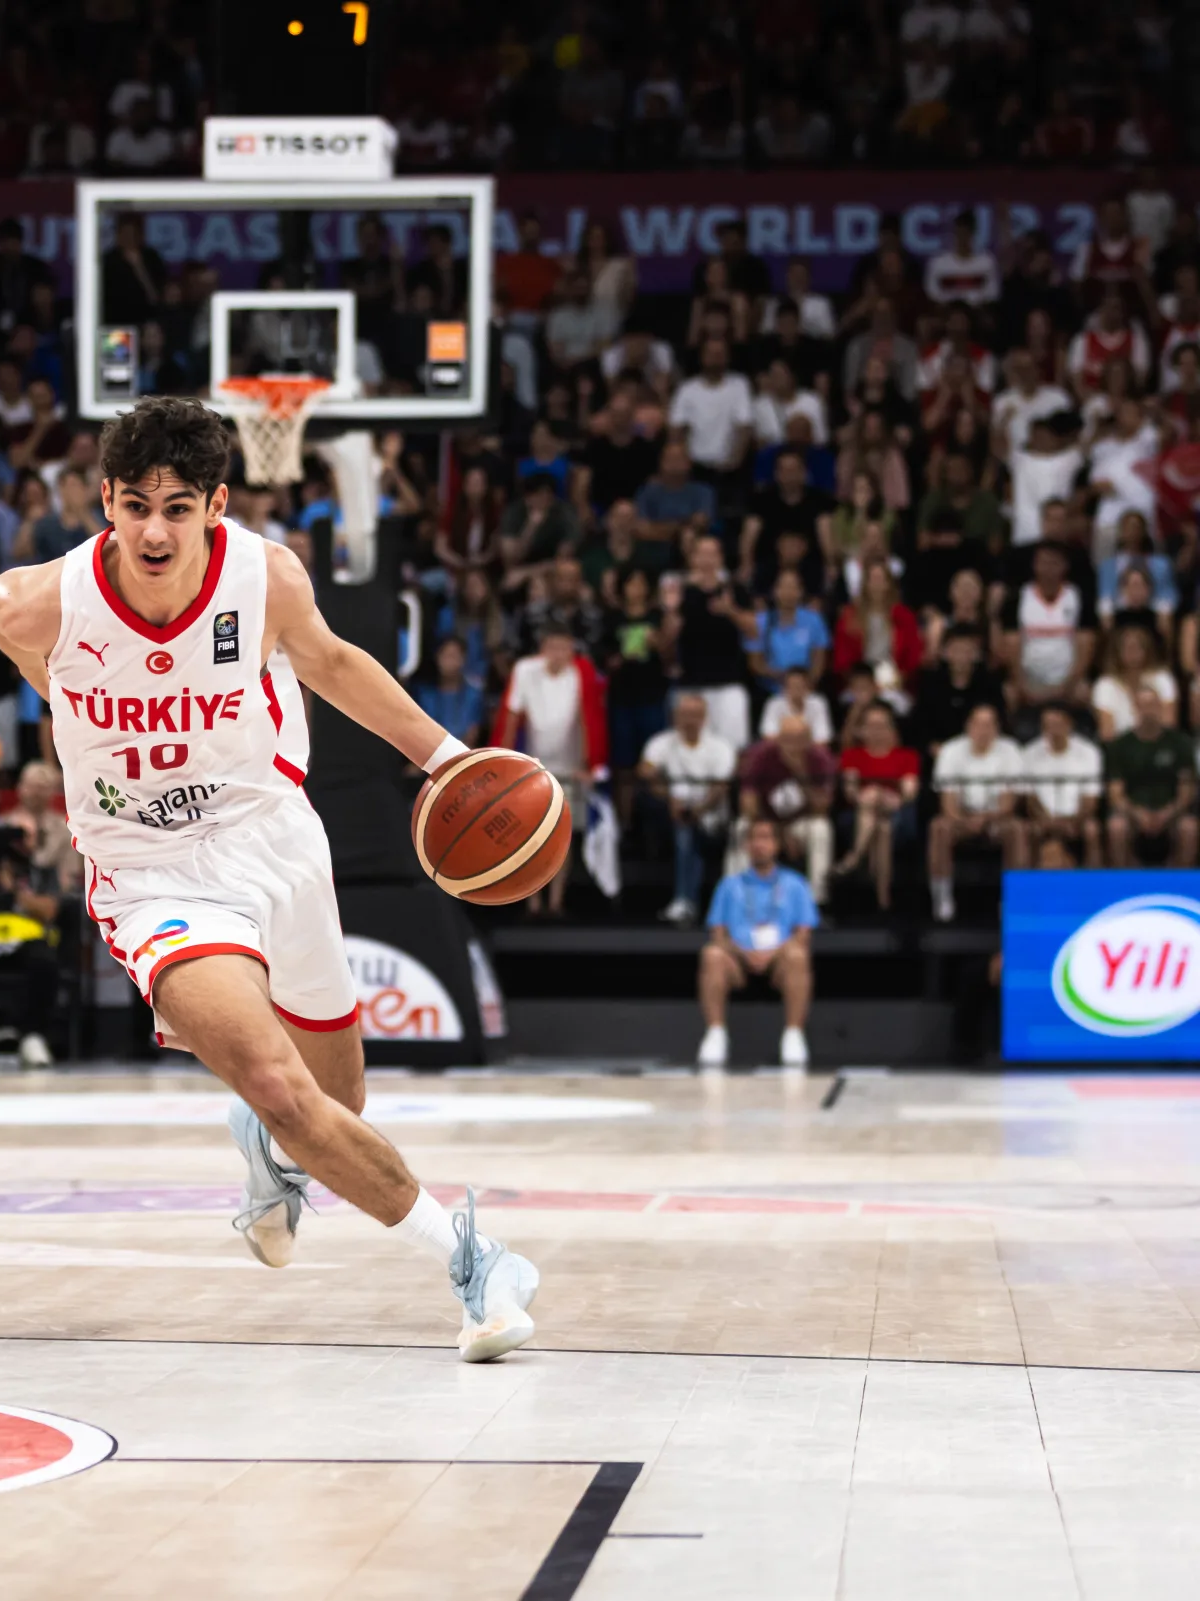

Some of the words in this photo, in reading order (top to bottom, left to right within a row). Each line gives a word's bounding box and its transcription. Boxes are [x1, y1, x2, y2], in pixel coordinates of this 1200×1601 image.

[264, 134, 368, 154] TISSOT
[620, 204, 881, 257] WORLD
[217, 640, 235, 651] FIBA
[61, 687, 245, 734] TÜRKİYE
[111, 743, 189, 780] 10
[1097, 940, 1188, 990] Yili
